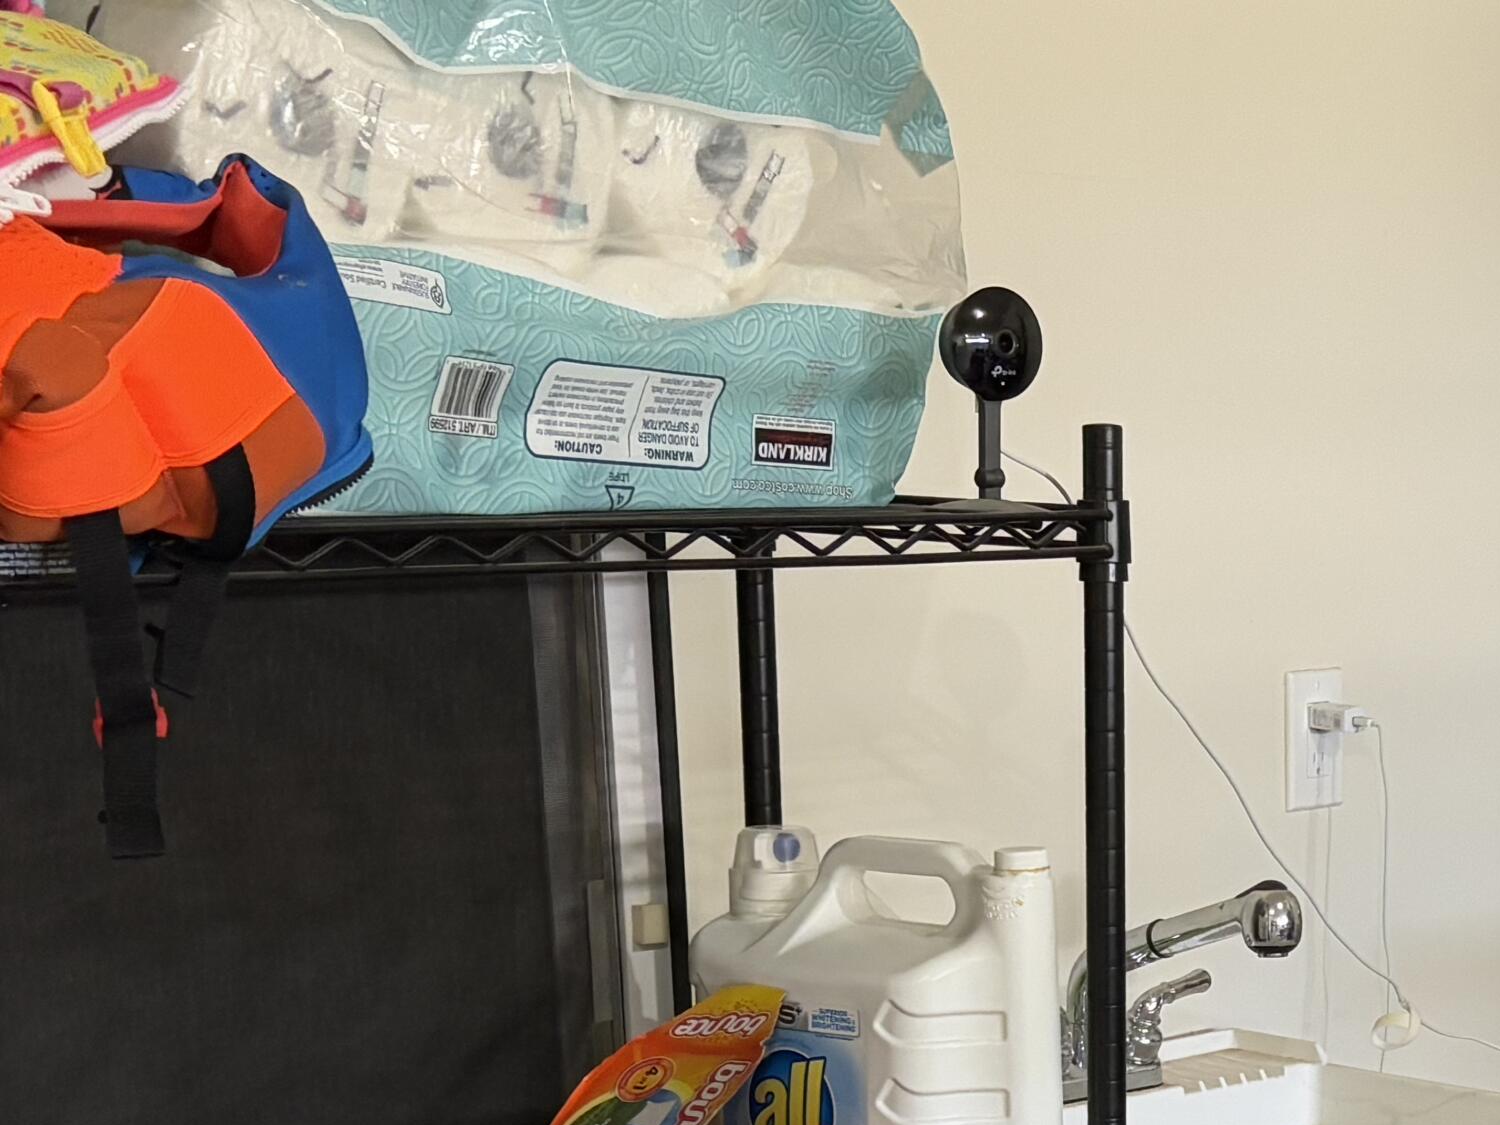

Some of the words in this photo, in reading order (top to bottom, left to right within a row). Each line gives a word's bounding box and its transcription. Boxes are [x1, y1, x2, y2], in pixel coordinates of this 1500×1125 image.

[638, 432, 667, 445] DANGER
[668, 434, 689, 446] AVOID
[690, 436, 699, 447] TO
[554, 440, 602, 454] CAUTION:
[758, 442, 827, 462] KIRKLAND
[644, 447, 694, 462] WARNING:
[673, 1013, 768, 1036] bounce
